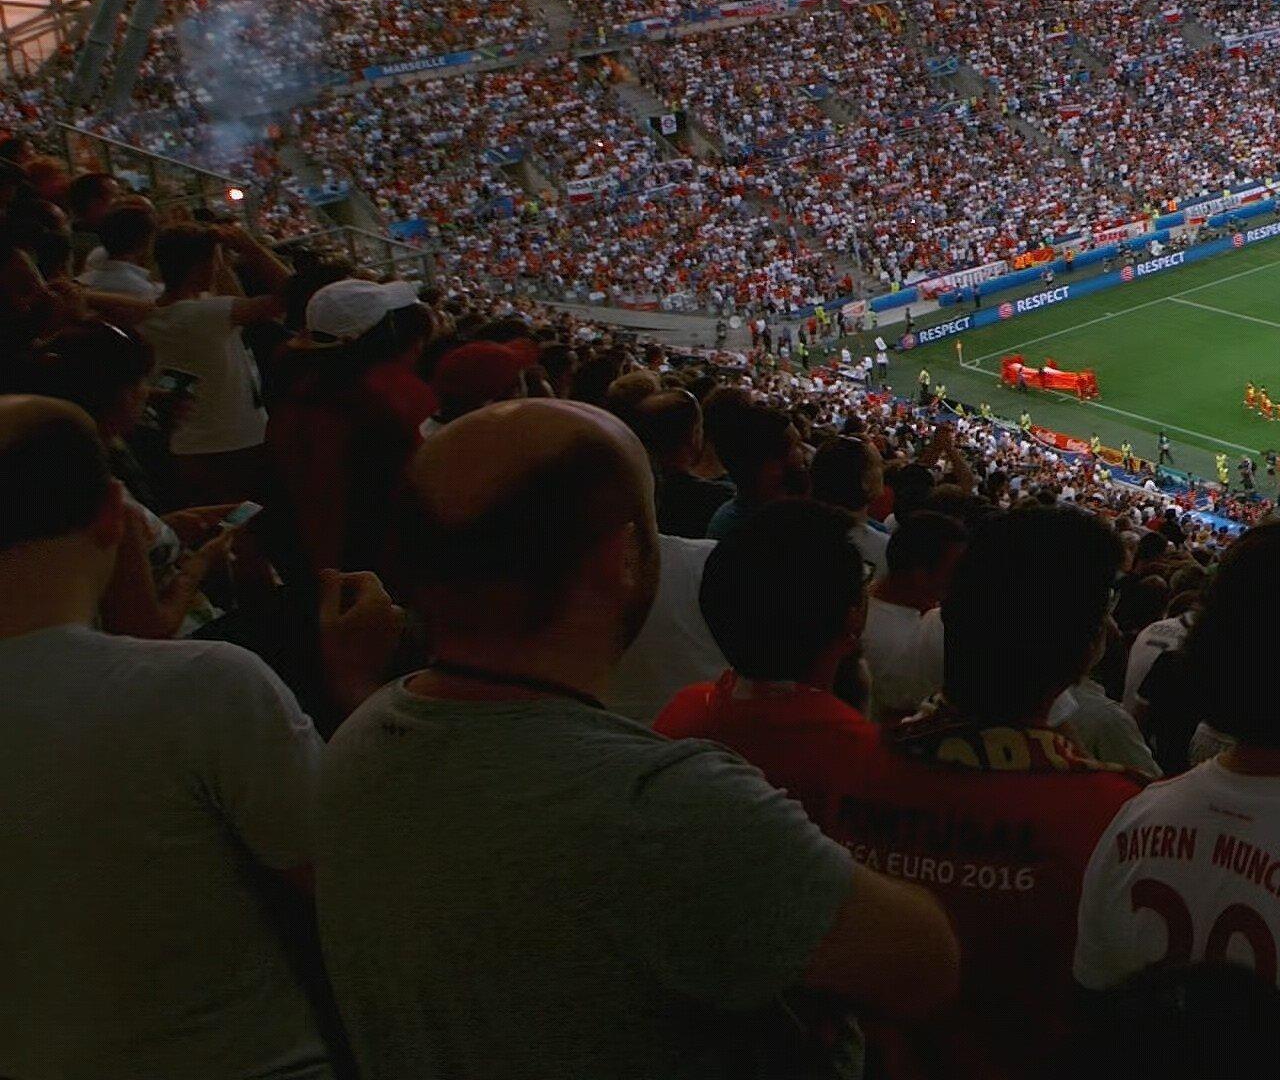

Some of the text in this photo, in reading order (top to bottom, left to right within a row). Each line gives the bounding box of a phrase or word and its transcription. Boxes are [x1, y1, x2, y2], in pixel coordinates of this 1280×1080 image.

[383, 56, 446, 75] MARSEILLE
[1137, 251, 1185, 276] RESPECT
[1016, 285, 1070, 313] RESPECT
[919, 316, 971, 344] RESPECT
[1117, 825, 1195, 865] BAYERN
[886, 852, 954, 884] EURO
[961, 863, 1035, 891] 2016
